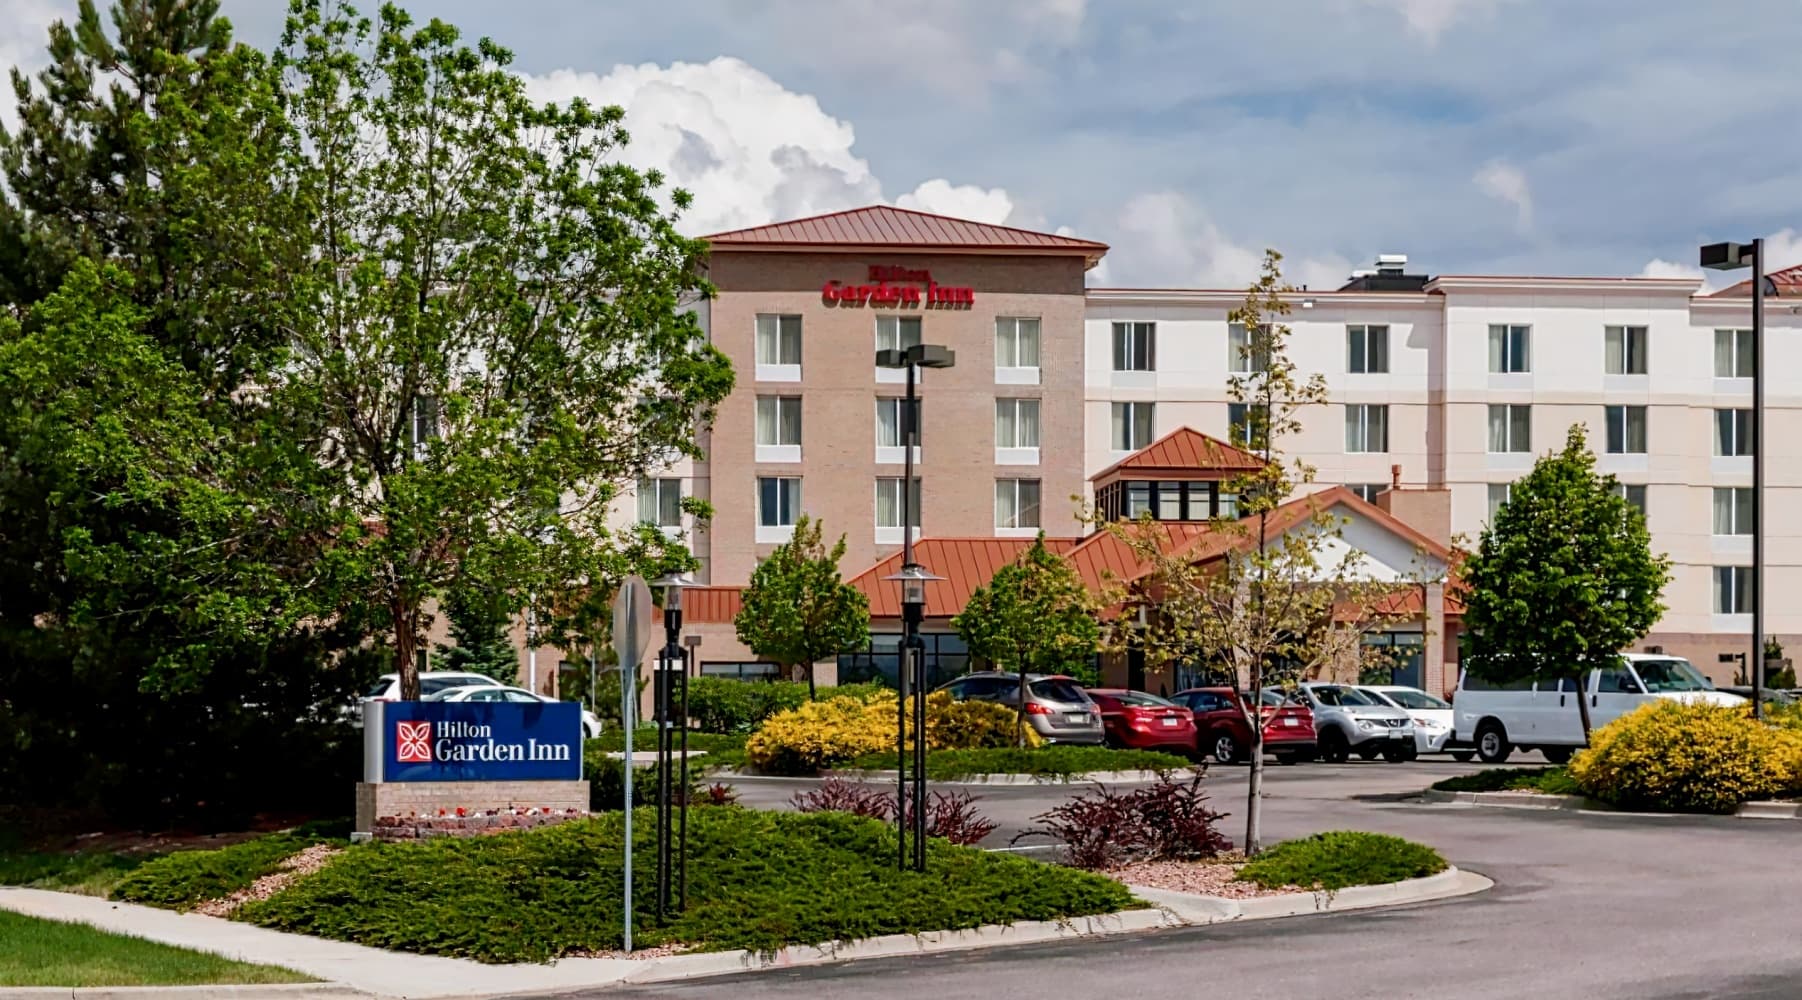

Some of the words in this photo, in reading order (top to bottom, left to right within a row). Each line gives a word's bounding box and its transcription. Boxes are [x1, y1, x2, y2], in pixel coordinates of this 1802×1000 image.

[822, 280, 921, 305] Garden
[927, 281, 975, 305] Inn
[437, 721, 491, 738] Hilton
[435, 738, 525, 762] Garden
[527, 738, 570, 761] Inn
